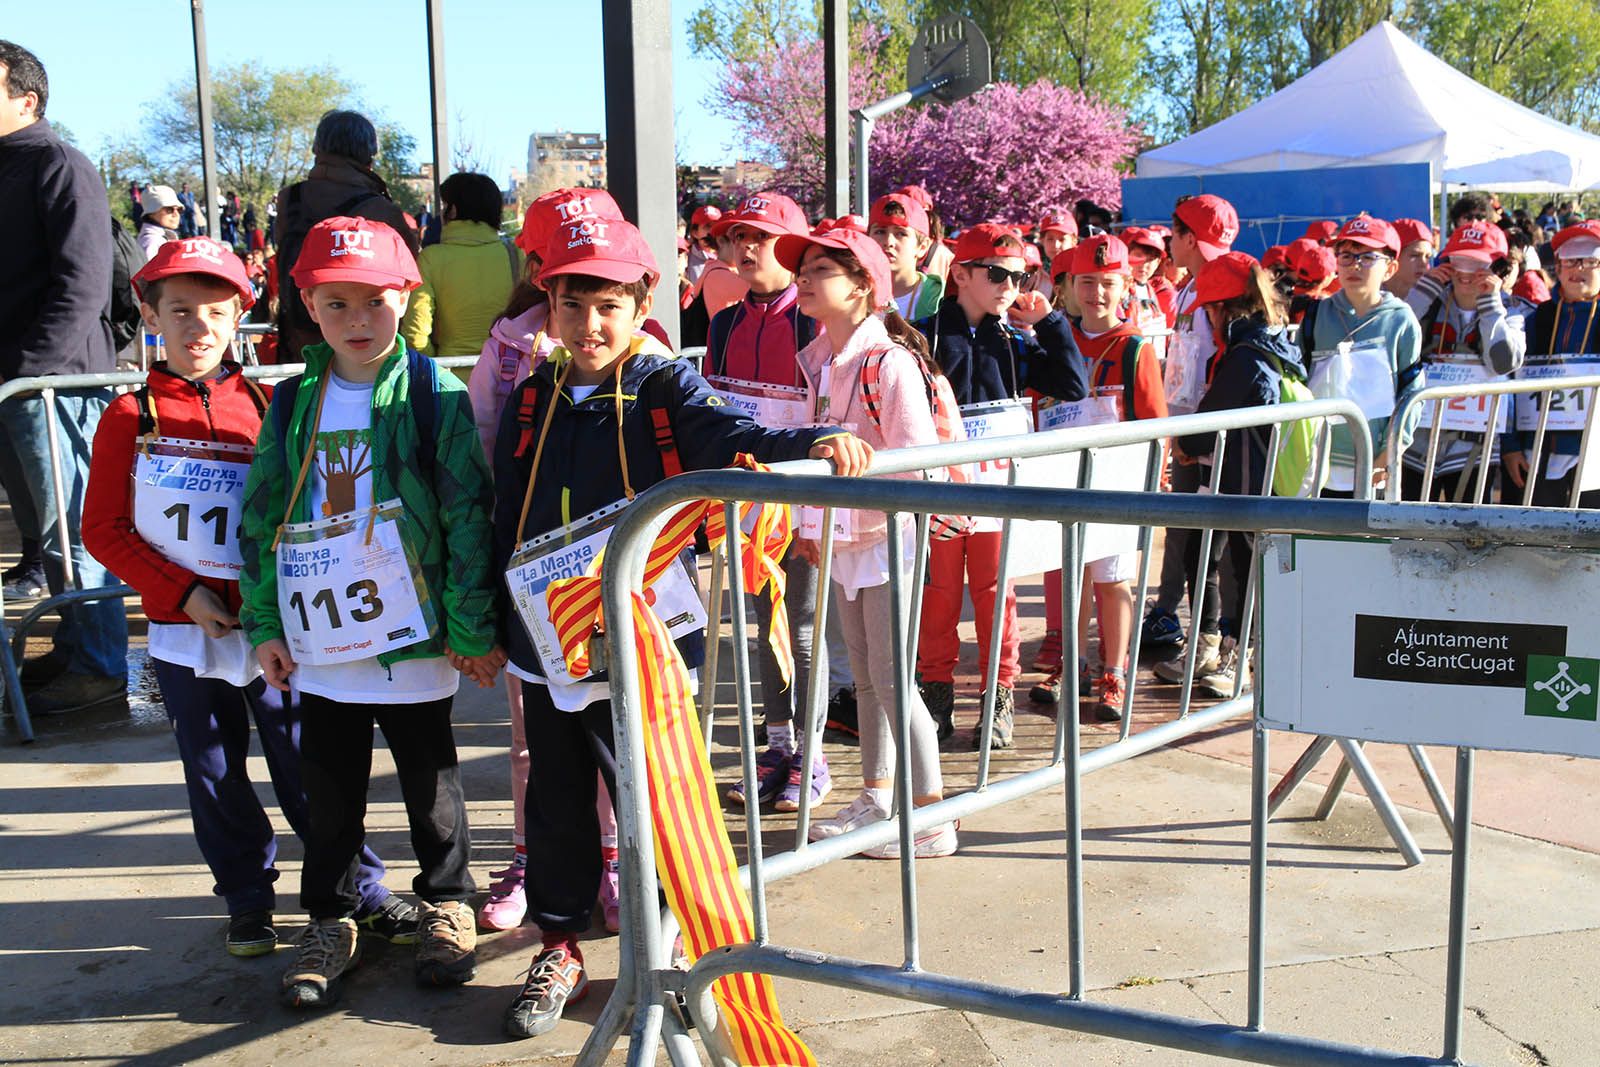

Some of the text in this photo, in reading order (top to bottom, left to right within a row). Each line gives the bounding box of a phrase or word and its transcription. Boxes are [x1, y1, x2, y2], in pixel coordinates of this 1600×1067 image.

[555, 197, 593, 220] TOT
[330, 229, 375, 249] TOT
[569, 222, 609, 239] TOT
[1529, 389, 1585, 412] 121
[963, 418, 987, 430] arxa
[183, 462, 237, 479] Marxa
[163, 502, 241, 546] 11
[289, 548, 330, 563] Marxa
[540, 544, 593, 576] Marxa
[293, 557, 340, 578] 2017"
[290, 579, 384, 631] 113
[1394, 627, 1509, 650] Ajuntament
[1387, 649, 1516, 675] de SantCugat
